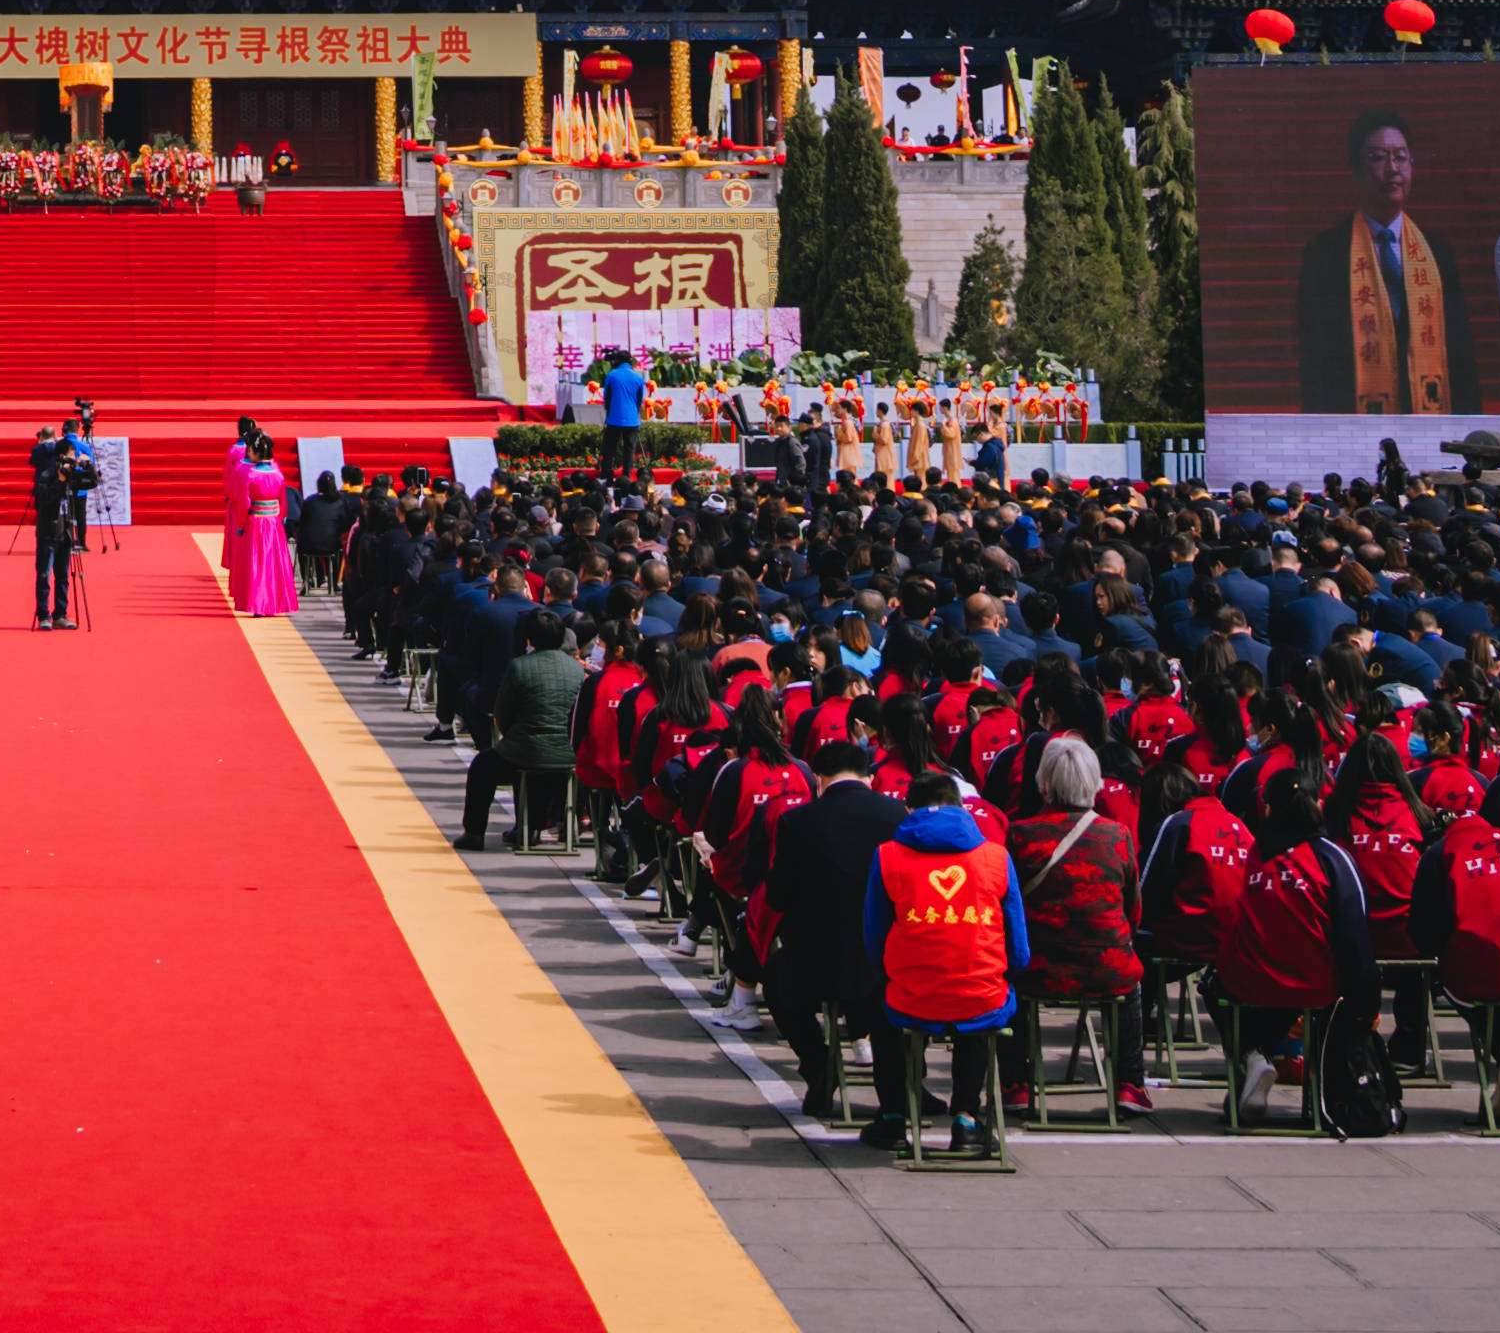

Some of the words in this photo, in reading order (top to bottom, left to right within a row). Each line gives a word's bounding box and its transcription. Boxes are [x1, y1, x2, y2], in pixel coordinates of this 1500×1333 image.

[906, 905, 994, 925] 义务志愿者
